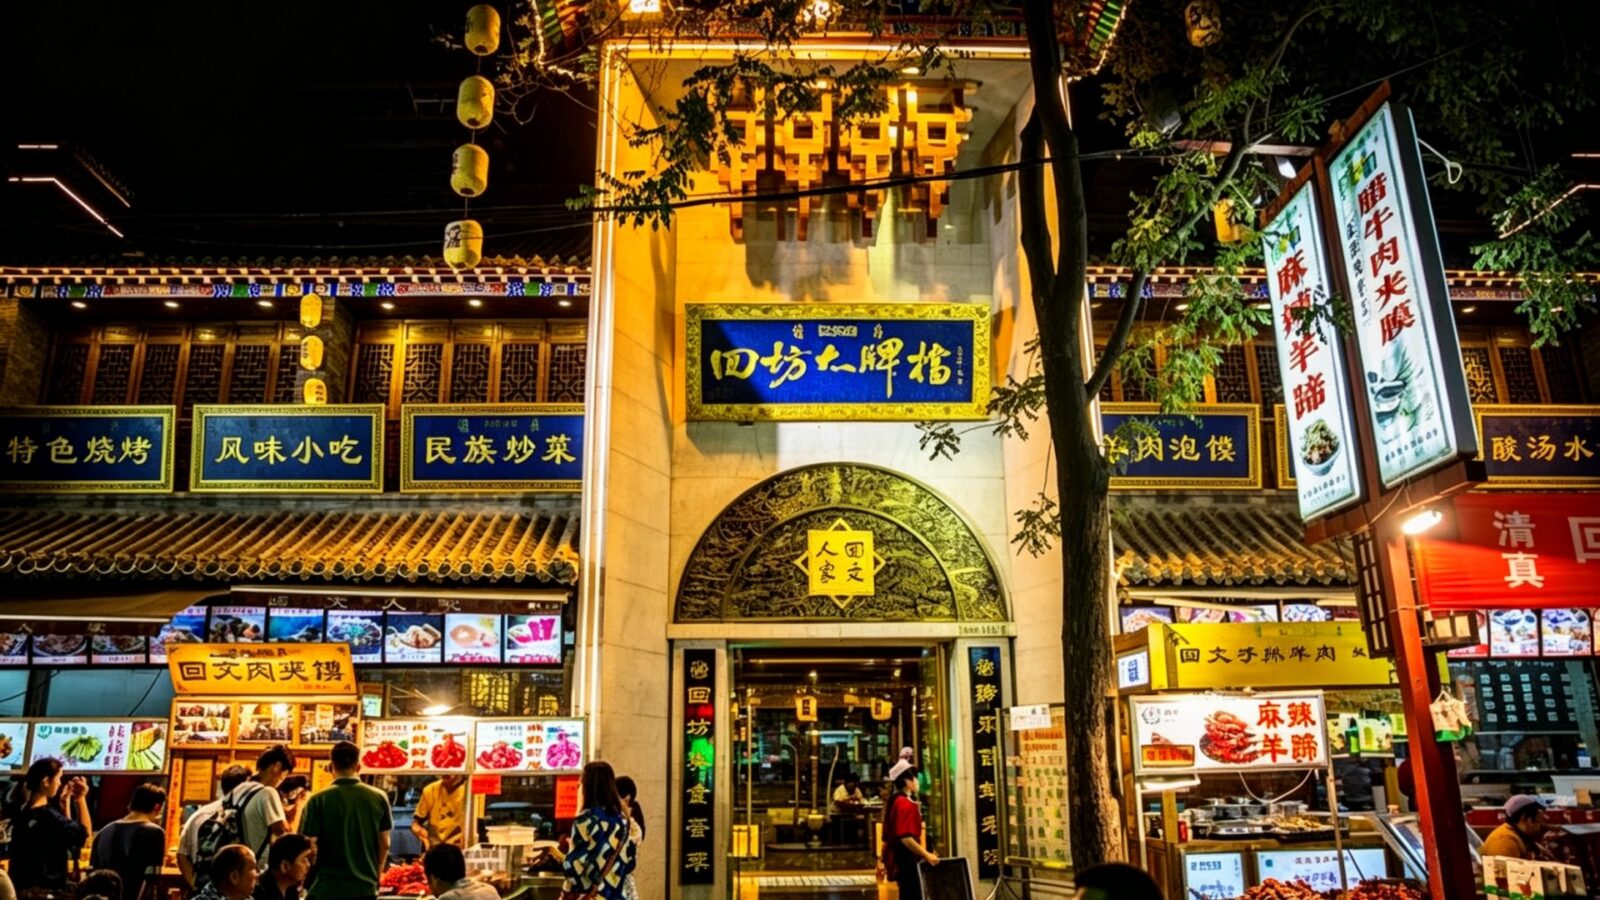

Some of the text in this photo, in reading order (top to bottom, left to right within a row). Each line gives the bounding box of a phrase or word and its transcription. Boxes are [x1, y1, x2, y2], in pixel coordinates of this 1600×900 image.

[6, 435, 153, 465] 特色烧烤
[215, 434, 363, 465] 风味小吃
[425, 433, 577, 465] 民族炒菜
[1103, 434, 1237, 465] 羊肉泡馍
[1493, 510, 1546, 588] 清真
